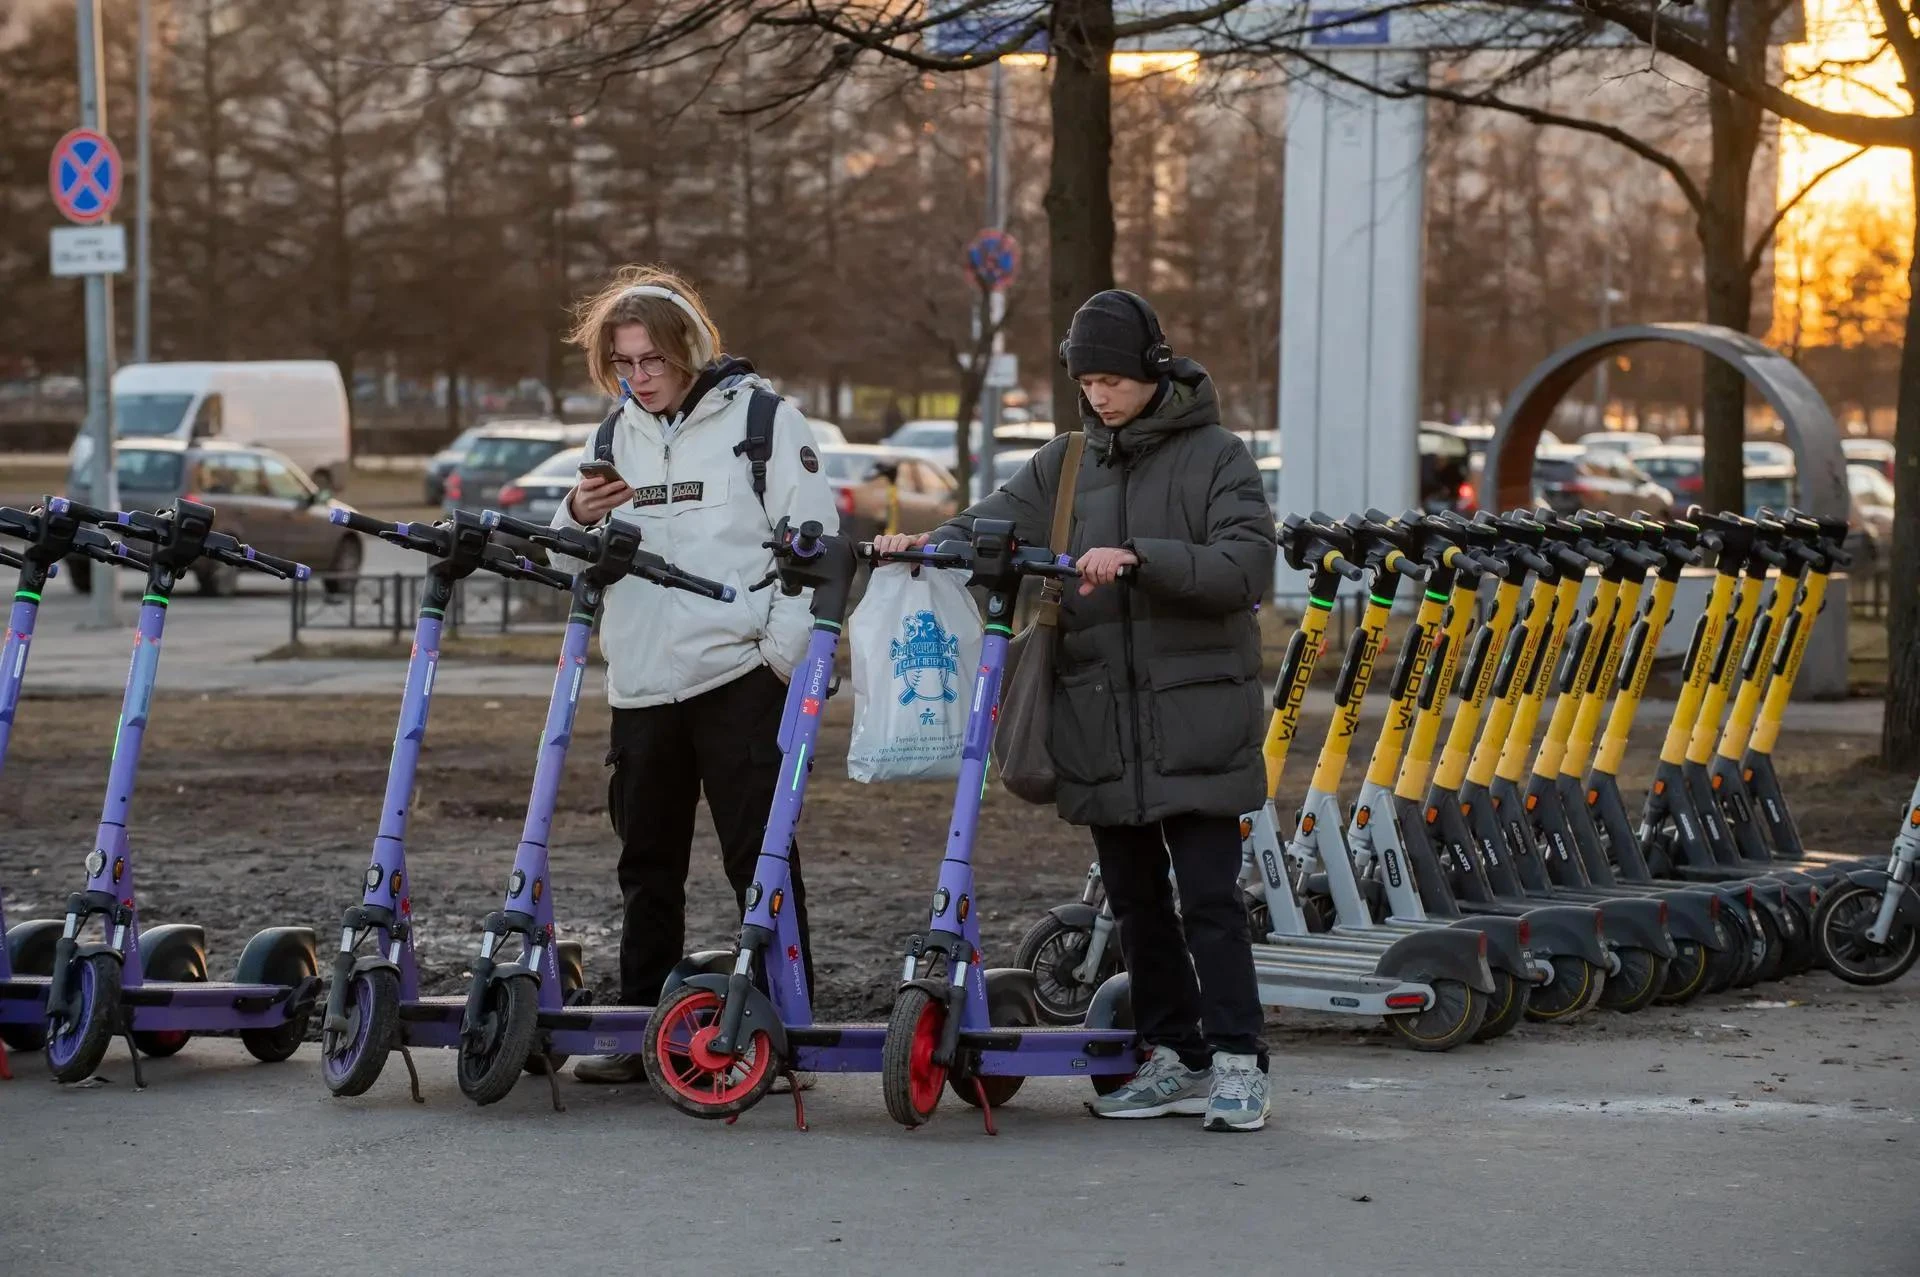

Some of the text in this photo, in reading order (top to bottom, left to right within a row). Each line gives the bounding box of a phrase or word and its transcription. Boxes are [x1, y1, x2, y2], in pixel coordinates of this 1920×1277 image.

[810, 657, 825, 695] ЮРЕНТ
[1278, 628, 1323, 740] WHOOSH
[1339, 626, 1384, 736] WHOOSH
[1393, 622, 1438, 730] WHOOSH
[1433, 659, 1456, 716] WHOOSH
[1473, 652, 1497, 709] WHOOSH
[1507, 649, 1533, 705] WHOOSH
[1536, 646, 1560, 701] WHOOSH
